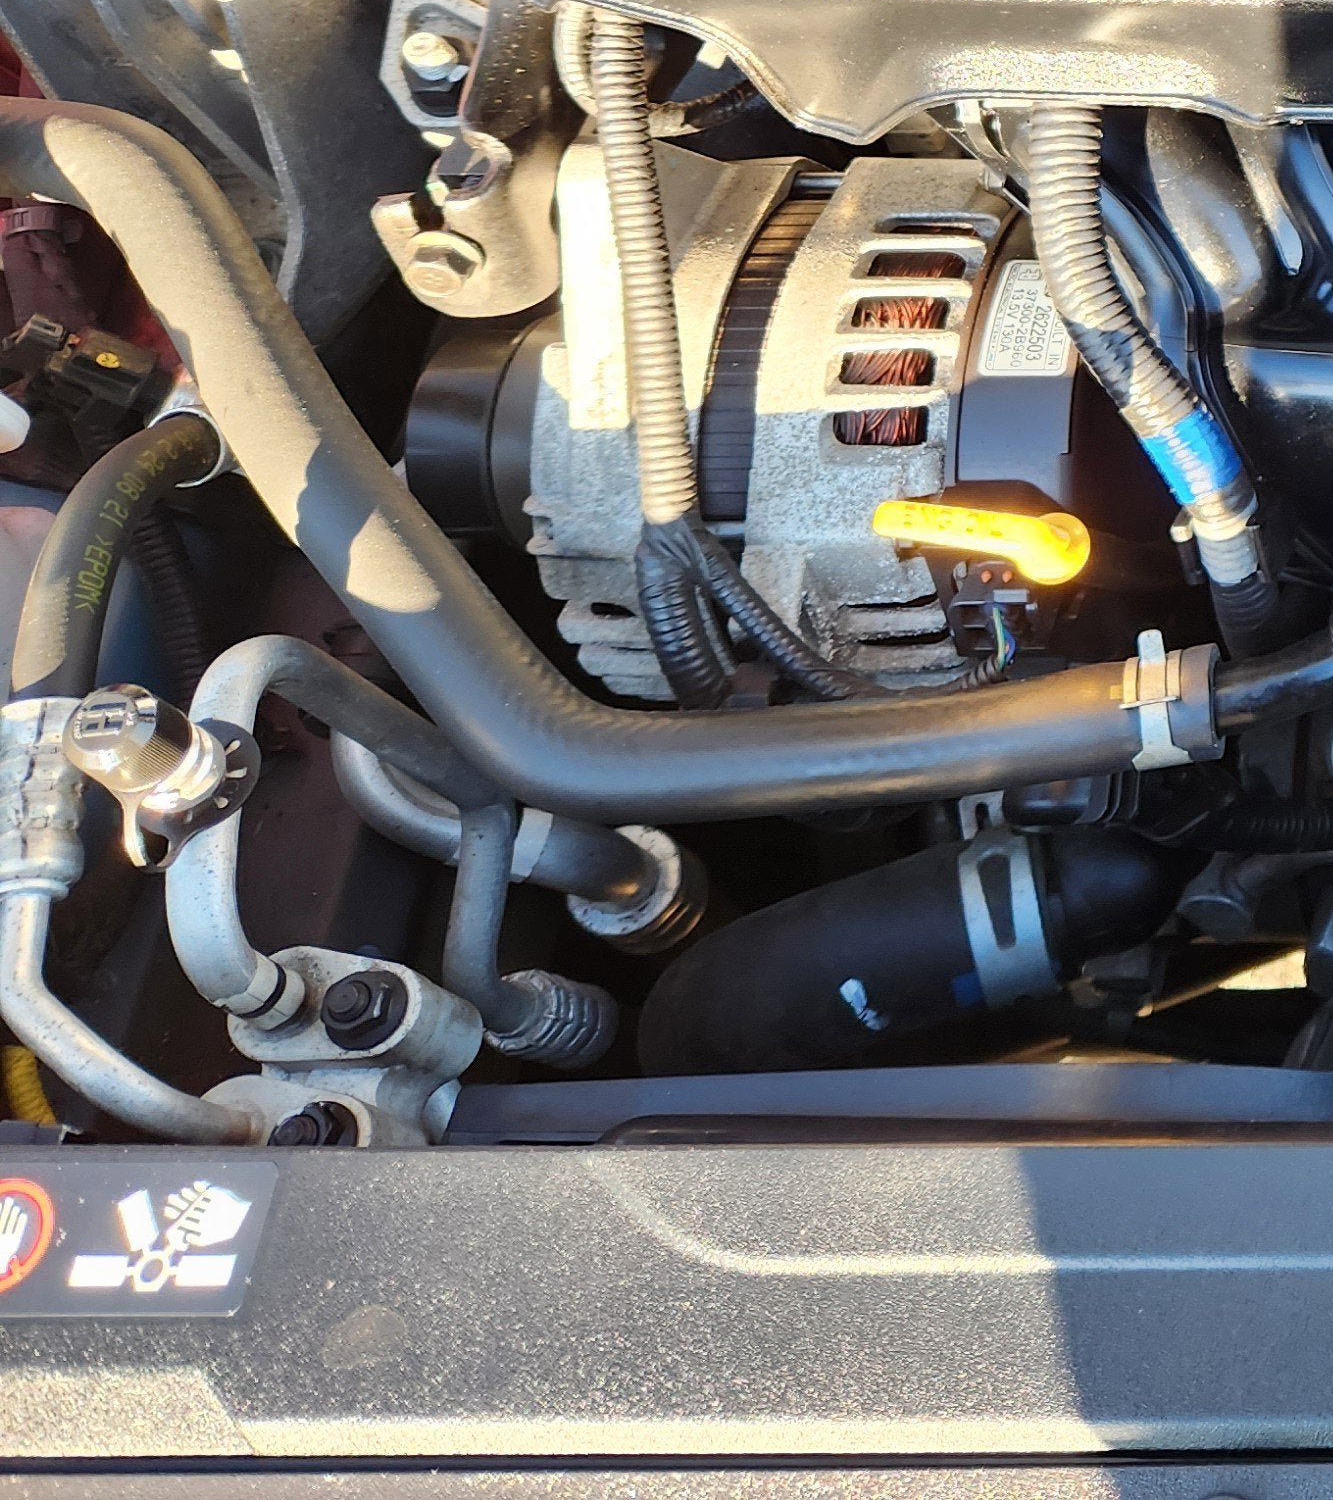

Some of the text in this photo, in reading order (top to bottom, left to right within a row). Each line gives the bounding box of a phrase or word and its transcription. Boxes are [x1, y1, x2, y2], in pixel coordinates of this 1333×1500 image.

[1007, 289, 1024, 319] 13.5V
[999, 323, 1015, 353] 130A
[1010, 289, 1038, 367] 37300-2B960
[1026, 305, 1052, 361] 2622503
[1048, 354, 1060, 366] IN
